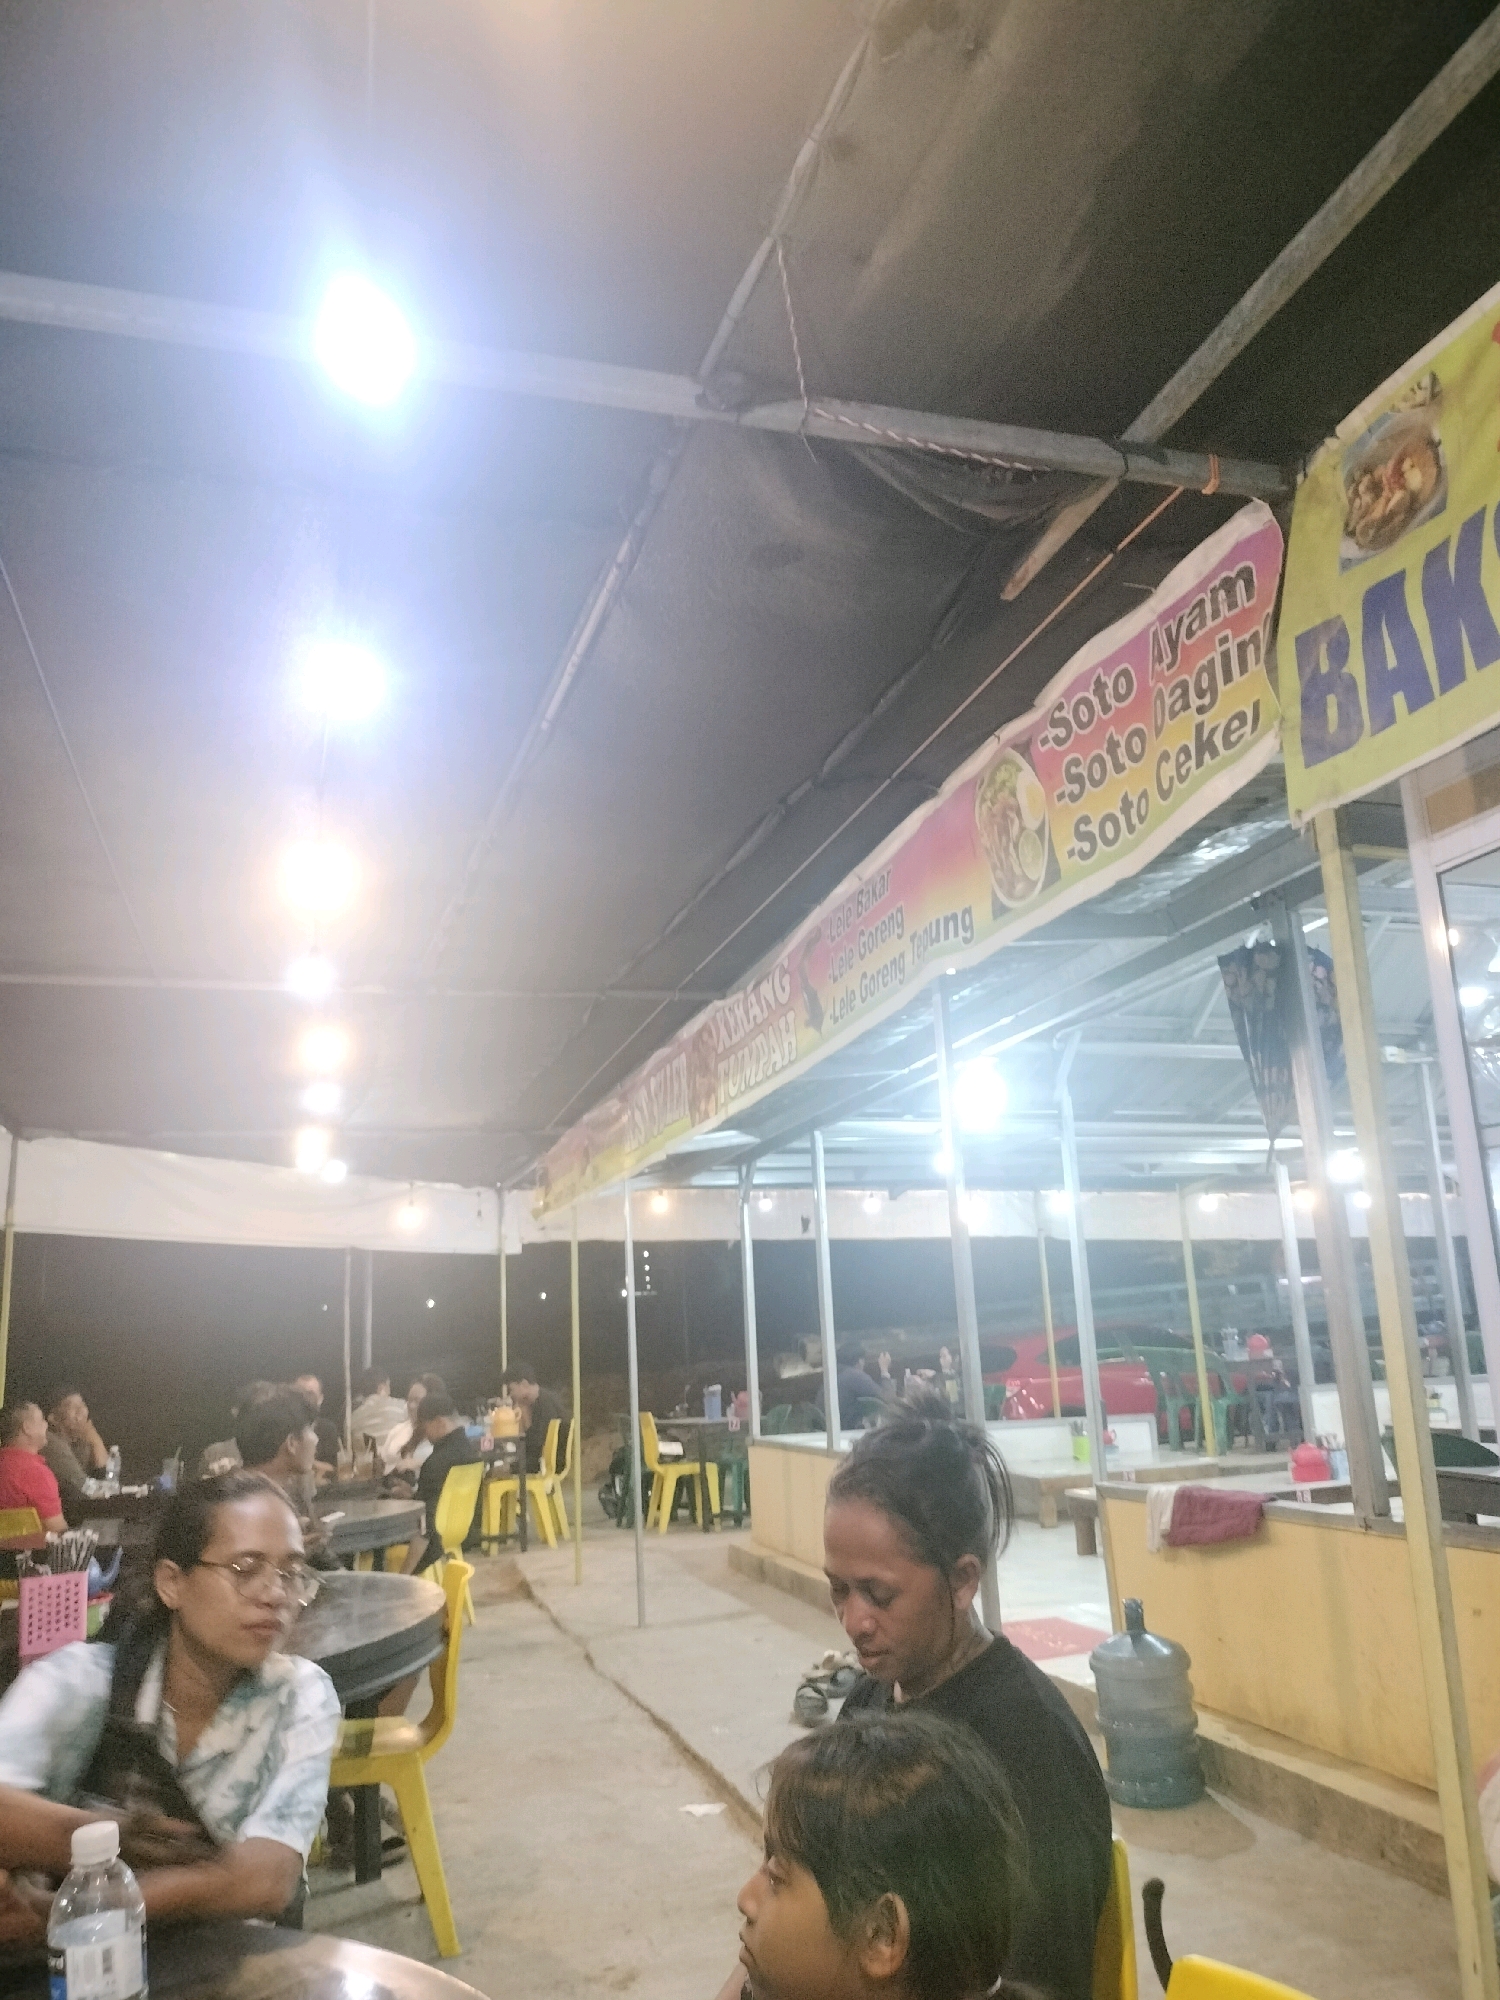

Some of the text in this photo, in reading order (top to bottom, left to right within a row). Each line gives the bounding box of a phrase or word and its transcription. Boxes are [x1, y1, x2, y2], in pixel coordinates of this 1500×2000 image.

[1151, 564, 1257, 682] Ayam
[1294, 495, 1500, 769] BAK
[857, 869, 892, 919] Bakar
[858, 905, 905, 961] Goreng
[859, 951, 906, 1004] Goreng
[909, 905, 975, 965] Tepung
[717, 1010, 797, 1104] TUMPAH
